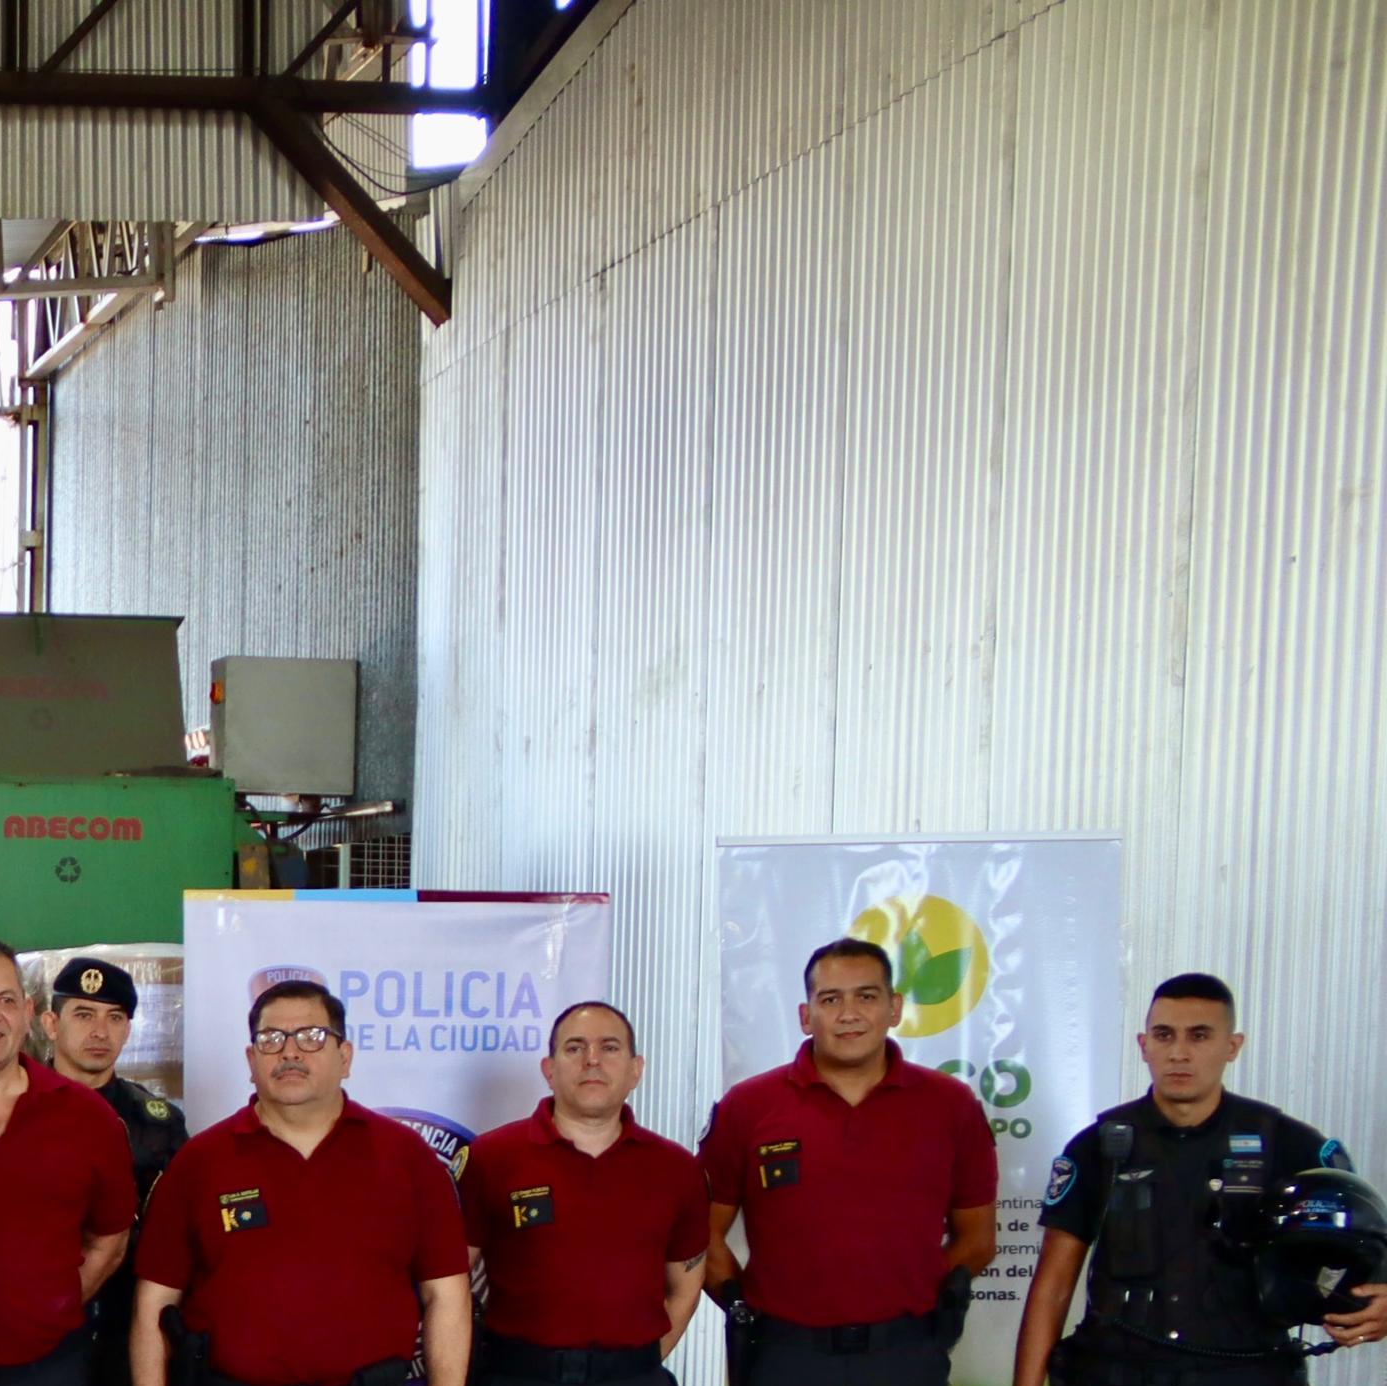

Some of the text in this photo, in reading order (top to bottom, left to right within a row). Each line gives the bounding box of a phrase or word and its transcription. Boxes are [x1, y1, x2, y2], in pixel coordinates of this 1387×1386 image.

[3, 814, 143, 841] ABECOM
[266, 970, 312, 983] POLICIA
[339, 969, 543, 1019] POLICIA
[385, 1025, 421, 1051] LA
[430, 1024, 542, 1052] CIUDAD
[1007, 1218, 1030, 1233] de
[1005, 1264, 1034, 1278] del
